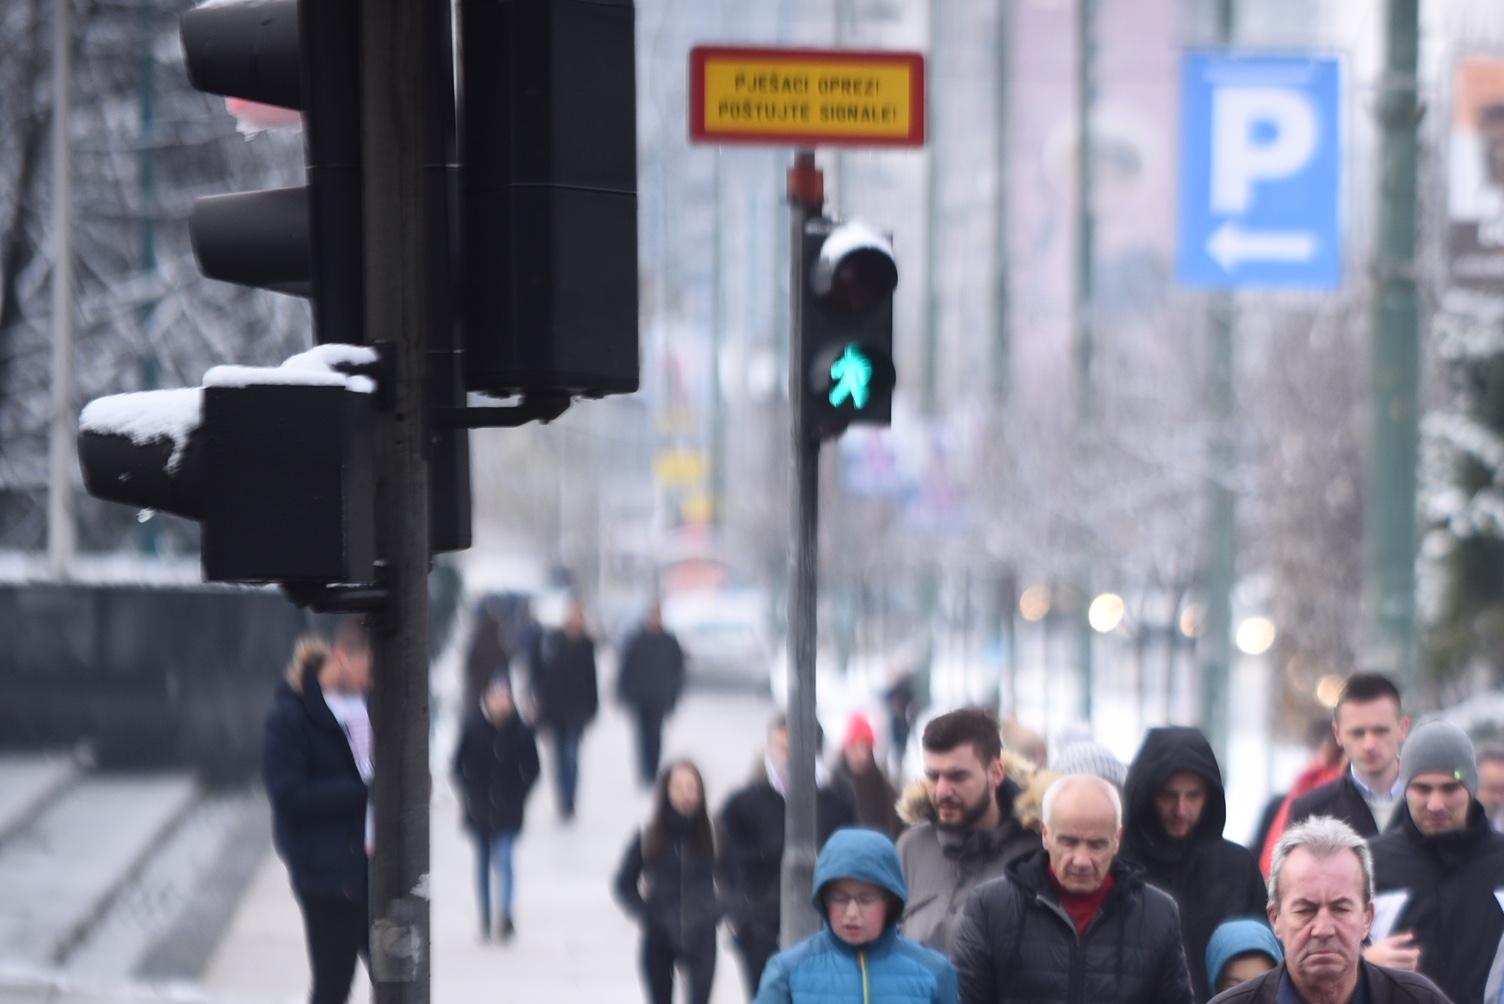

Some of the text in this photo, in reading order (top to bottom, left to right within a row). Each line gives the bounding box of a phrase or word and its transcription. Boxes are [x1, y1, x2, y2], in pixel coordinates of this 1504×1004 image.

[735, 72, 880, 96] PJEŠACI OPREZ!
[718, 98, 896, 123] POŠTUJTE SIGNALE!
[1211, 86, 1318, 214] P
